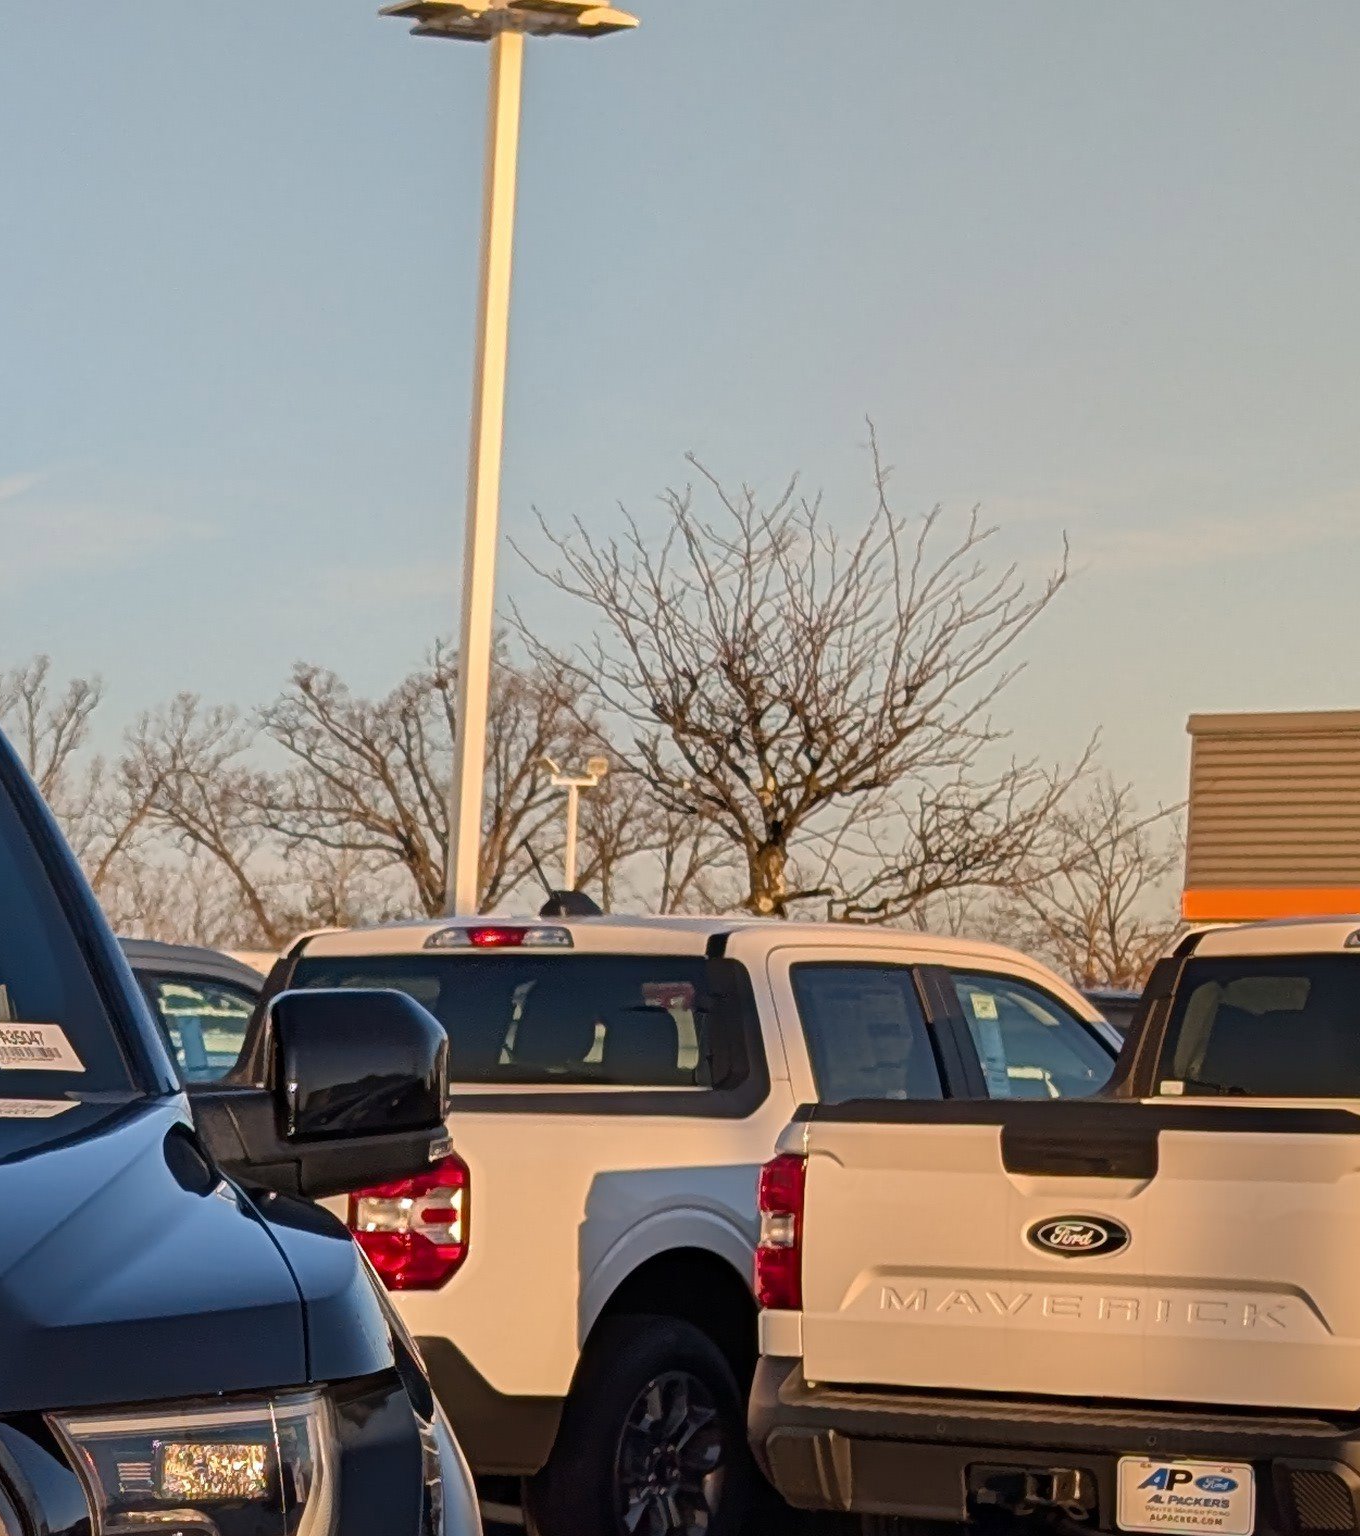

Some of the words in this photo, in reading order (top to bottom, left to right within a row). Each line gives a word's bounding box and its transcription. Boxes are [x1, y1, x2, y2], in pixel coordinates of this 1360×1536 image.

[1050, 1225, 1095, 1246] Ford
[879, 1285, 1288, 1330] MAVERICK
[1137, 1467, 1193, 1491] AP
[1167, 1495, 1230, 1509] PACKERS
